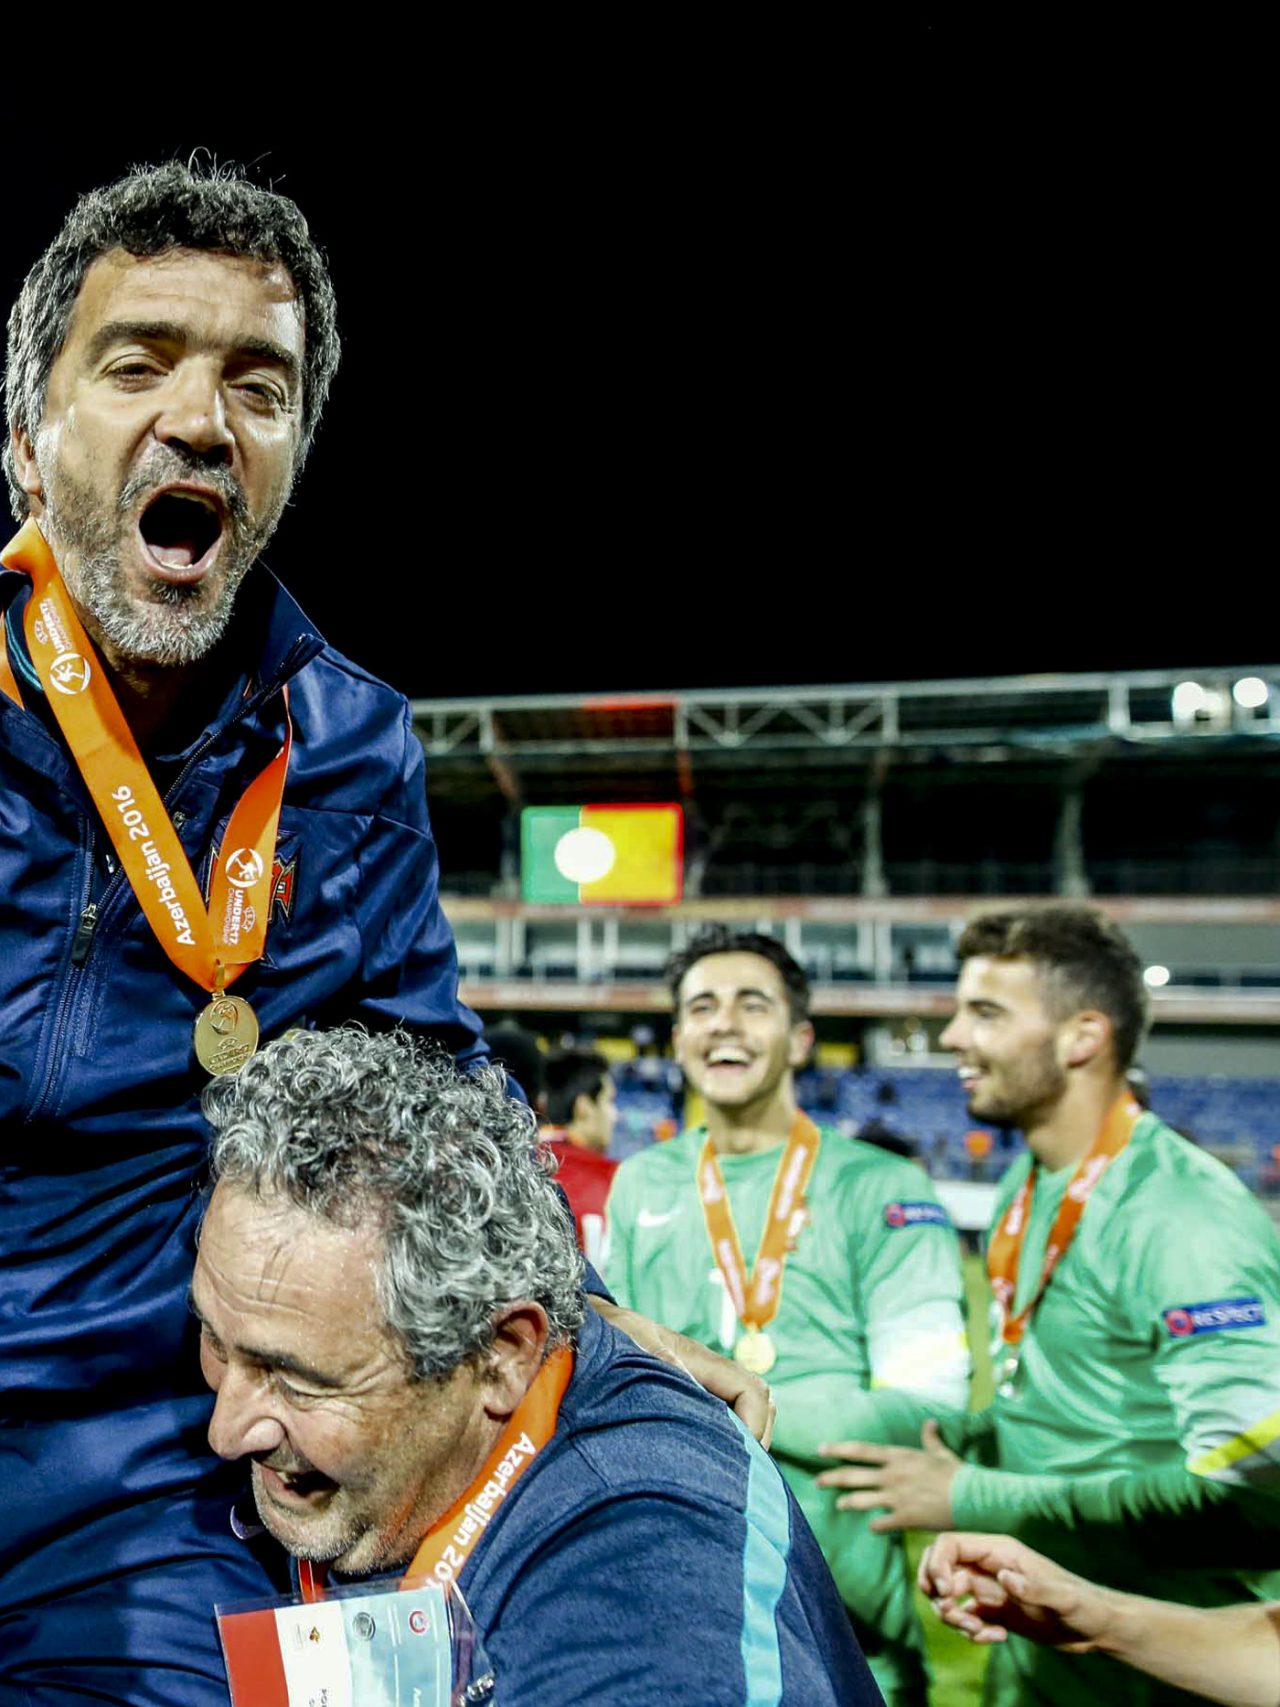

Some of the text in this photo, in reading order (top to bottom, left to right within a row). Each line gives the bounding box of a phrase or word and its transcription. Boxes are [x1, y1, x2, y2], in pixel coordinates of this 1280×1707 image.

[111, 785, 196, 945] Azerbaijan 2016
[452, 1432, 537, 1546] Azerbaijan
